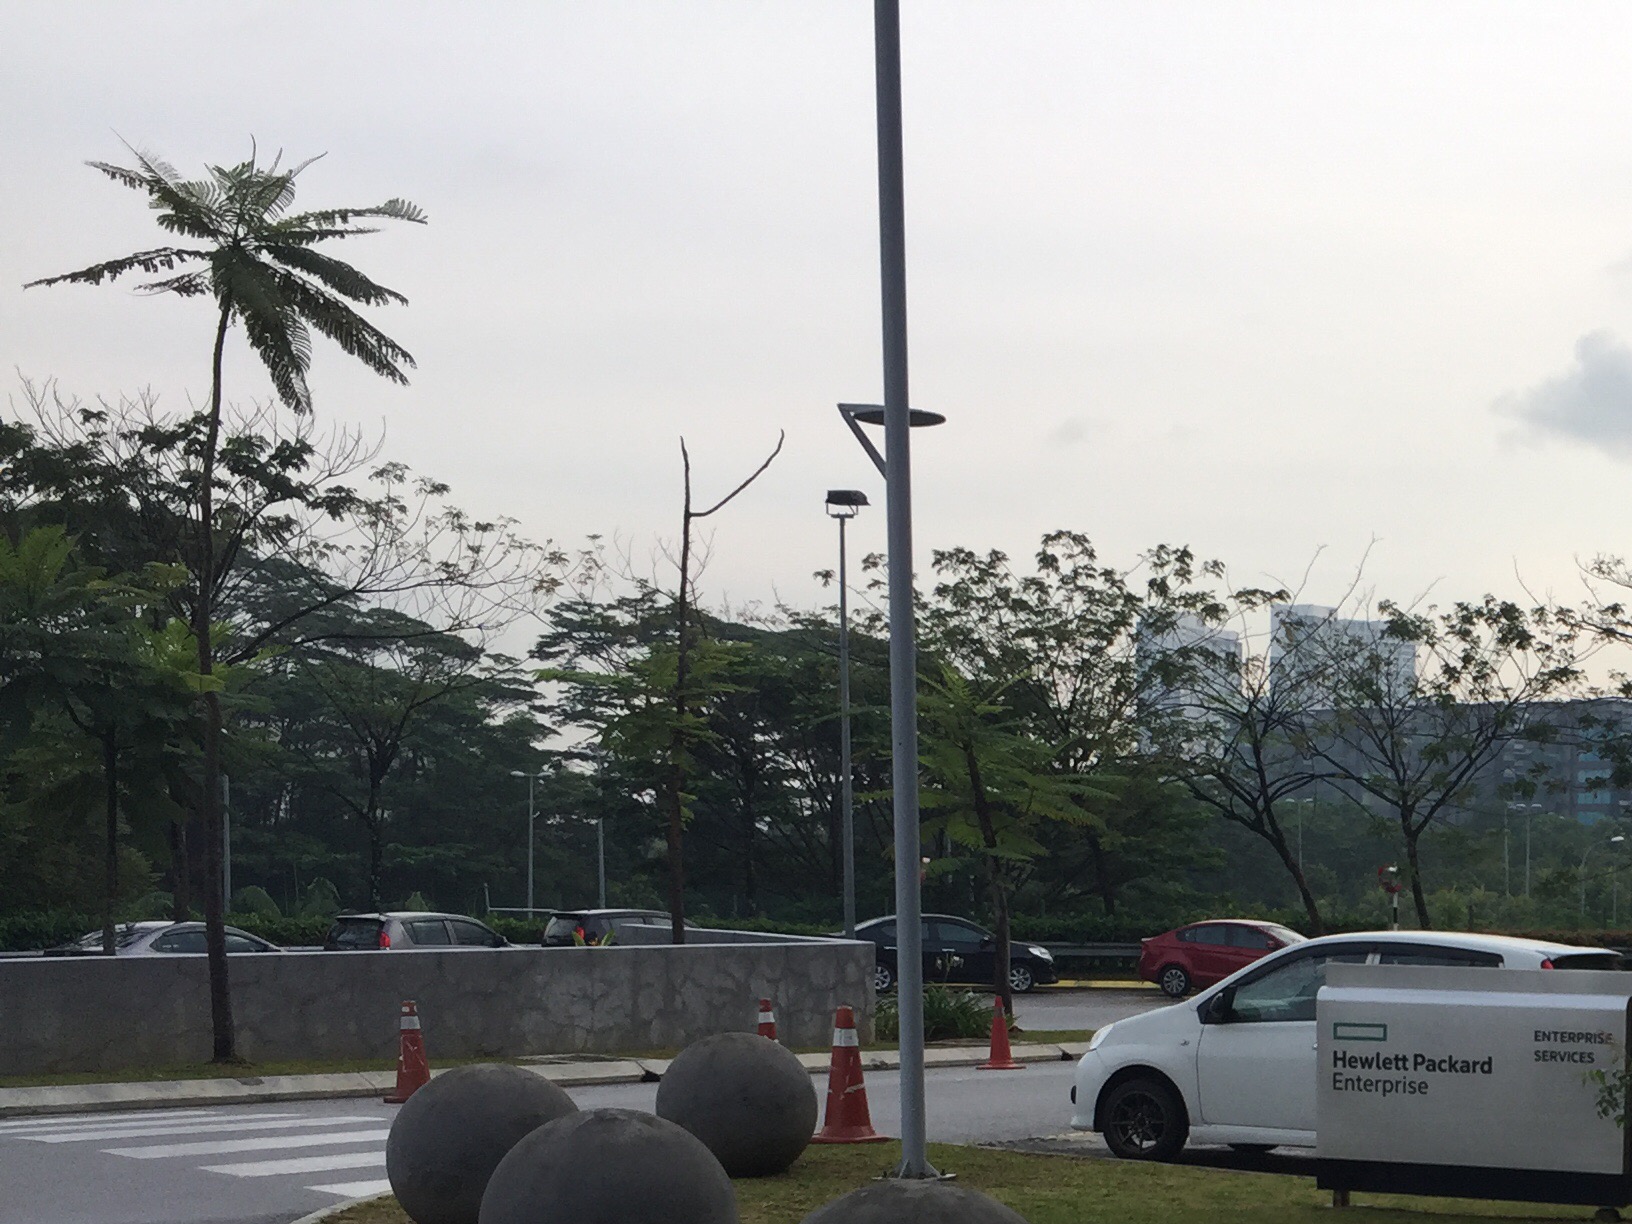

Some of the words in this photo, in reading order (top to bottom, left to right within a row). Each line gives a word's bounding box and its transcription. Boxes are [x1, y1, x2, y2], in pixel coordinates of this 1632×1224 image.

[1534, 1030, 1613, 1044] ENTERPRISE
[1333, 1050, 1409, 1072] Hewlett
[1413, 1053, 1493, 1075] Packard
[1534, 1050, 1595, 1063] SERVICES
[1332, 1072, 1429, 1097] Enterprise
